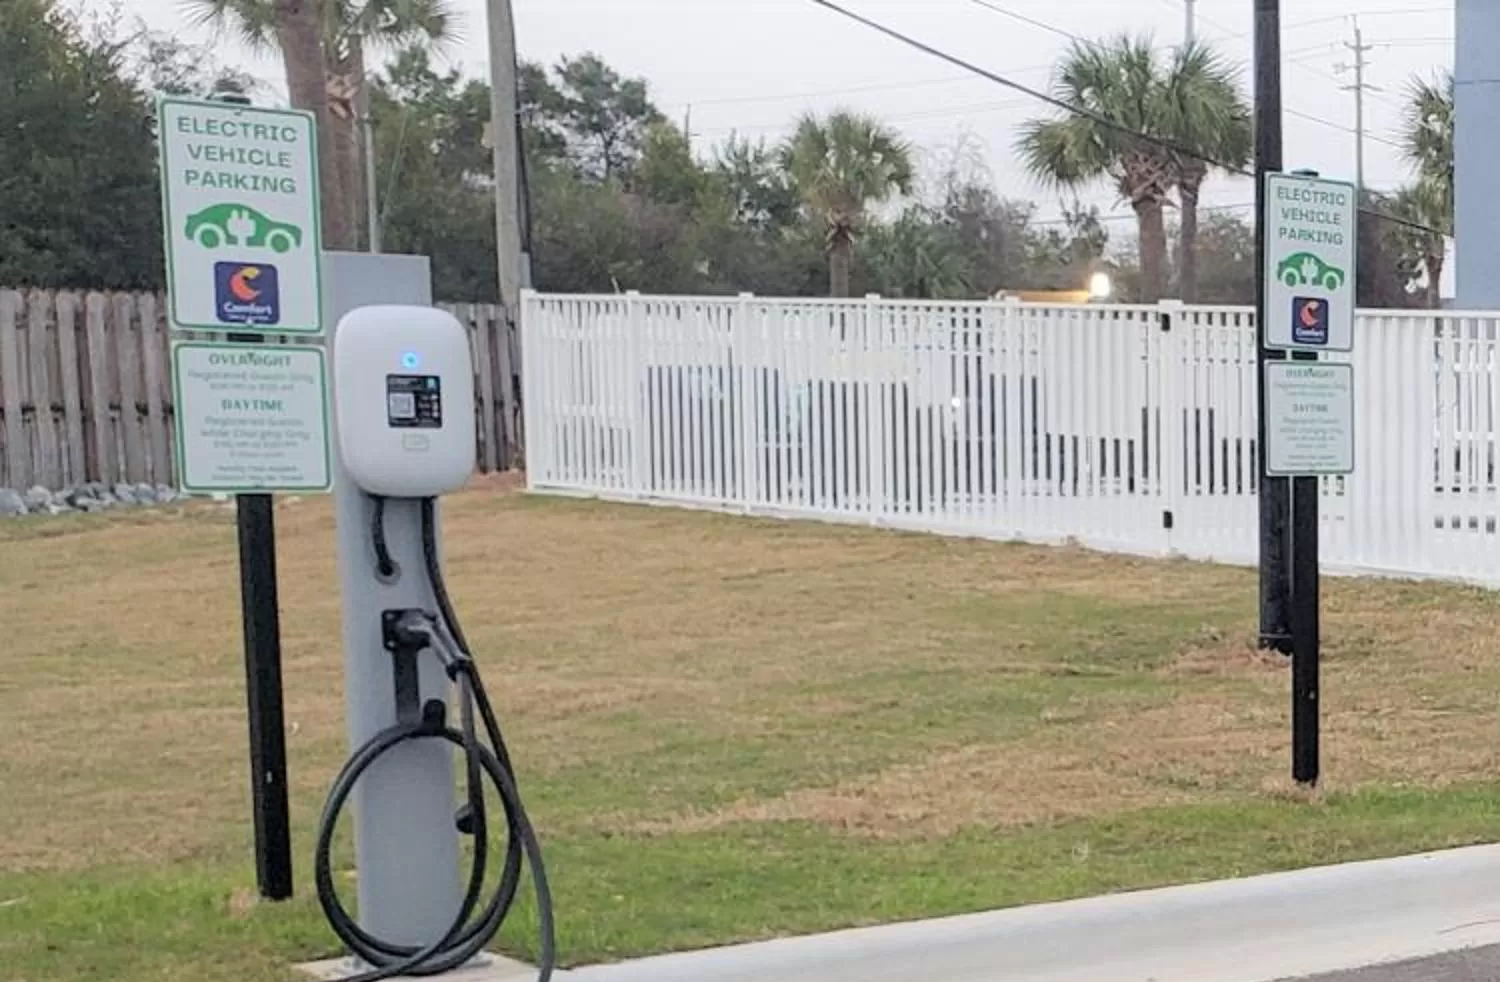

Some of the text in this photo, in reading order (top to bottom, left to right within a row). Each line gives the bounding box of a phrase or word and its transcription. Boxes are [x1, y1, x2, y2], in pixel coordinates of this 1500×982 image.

[177, 116, 297, 142] ELECTRIC
[186, 143, 292, 168] VEHICLE
[184, 169, 296, 193] PARKING
[1277, 186, 1345, 206] ELECTRIC
[1280, 207, 1341, 226] VEHICLE
[1278, 227, 1343, 245] PARKING
[223, 301, 272, 315] Comfort
[221, 399, 285, 412] DAYTIME
